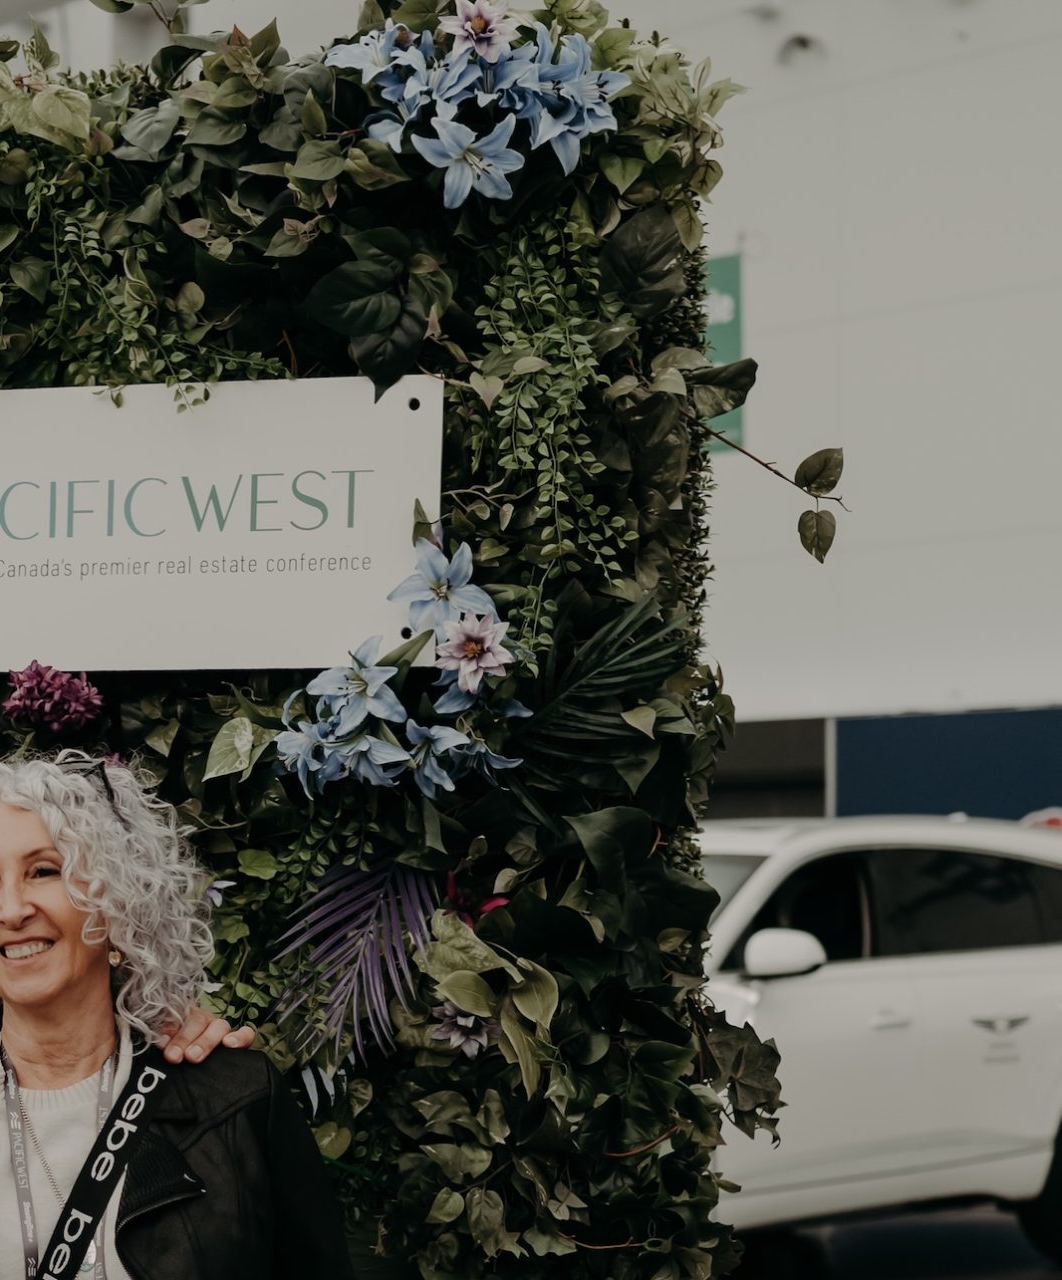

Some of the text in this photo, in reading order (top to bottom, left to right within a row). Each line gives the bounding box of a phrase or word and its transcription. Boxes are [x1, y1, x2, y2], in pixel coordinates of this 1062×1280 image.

[181, 469, 375, 532] WEST
[79, 556, 150, 581] premier
[157, 554, 192, 575] real
[199, 556, 258, 575] estate
[266, 553, 372, 573] conference
[90, 1065, 167, 1183] bebe
